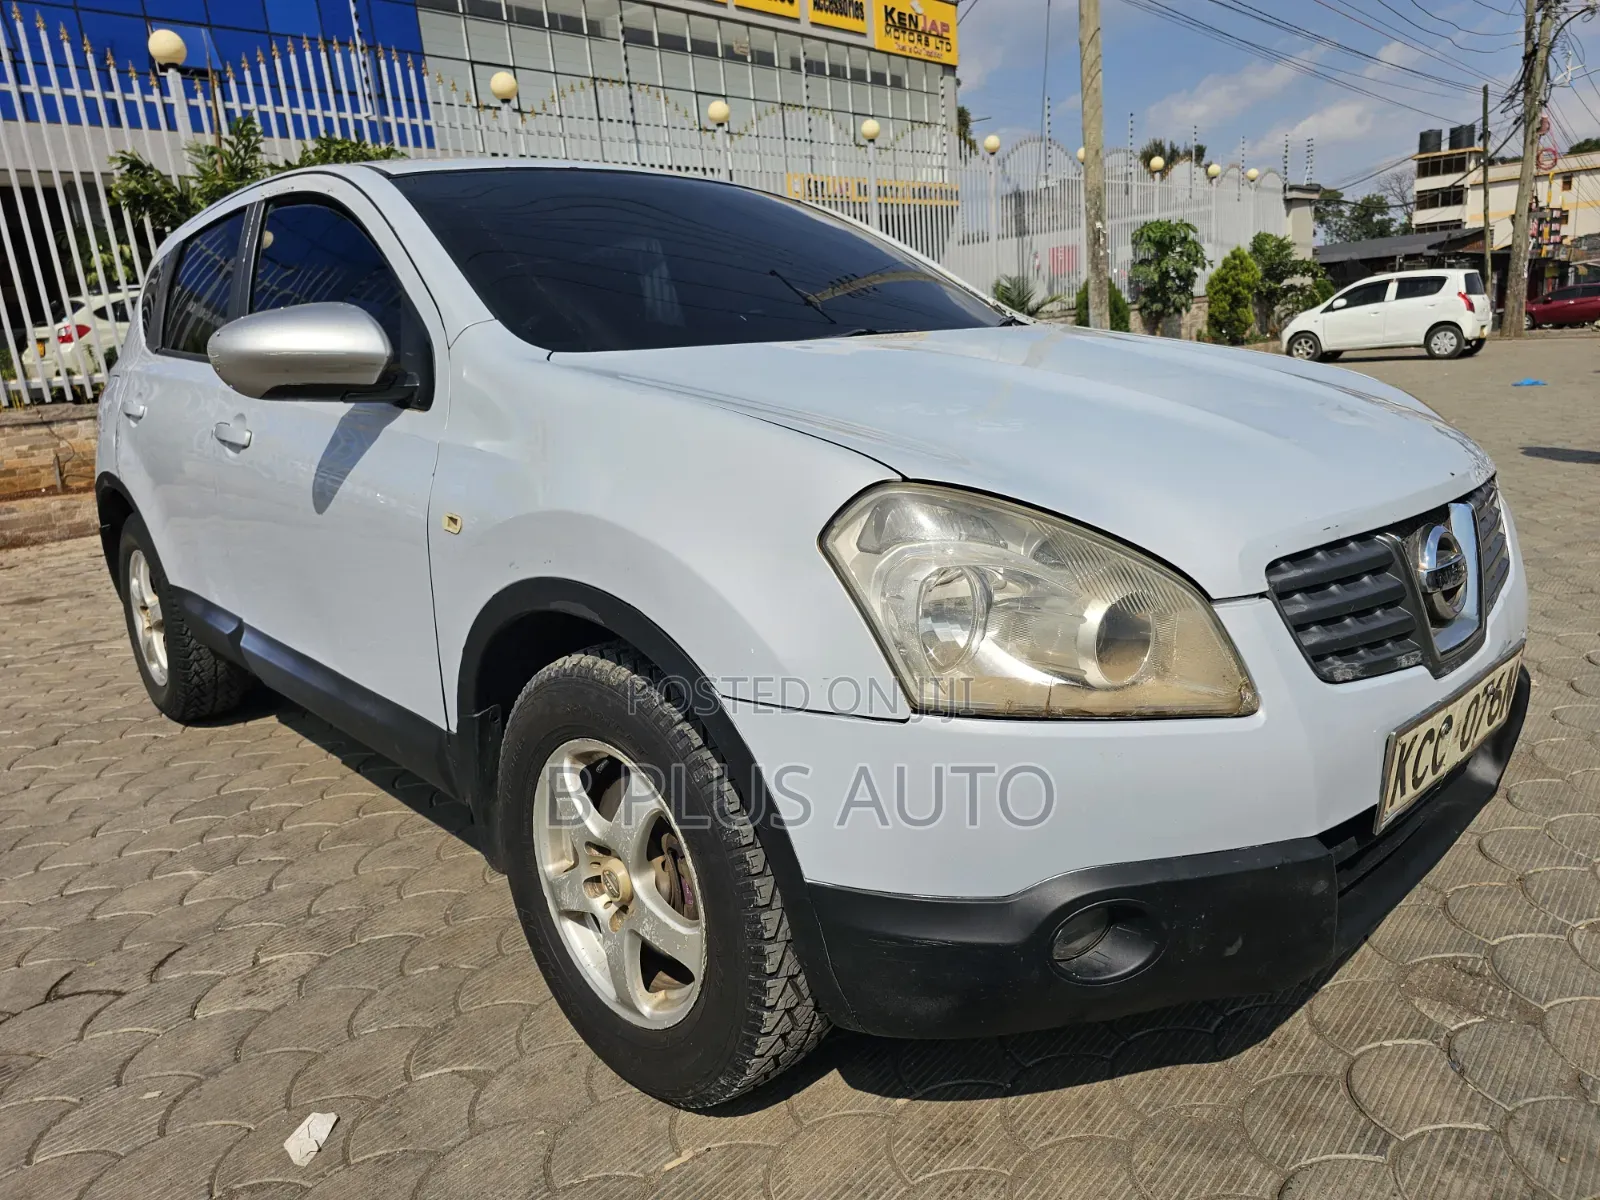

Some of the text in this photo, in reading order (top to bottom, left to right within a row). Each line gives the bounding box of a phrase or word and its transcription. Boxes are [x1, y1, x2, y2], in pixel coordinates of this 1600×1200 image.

[884, 5, 950, 37] KENJAP
[884, 25, 953, 53] MOTORS LTD
[1389, 714, 1454, 808] KCC
